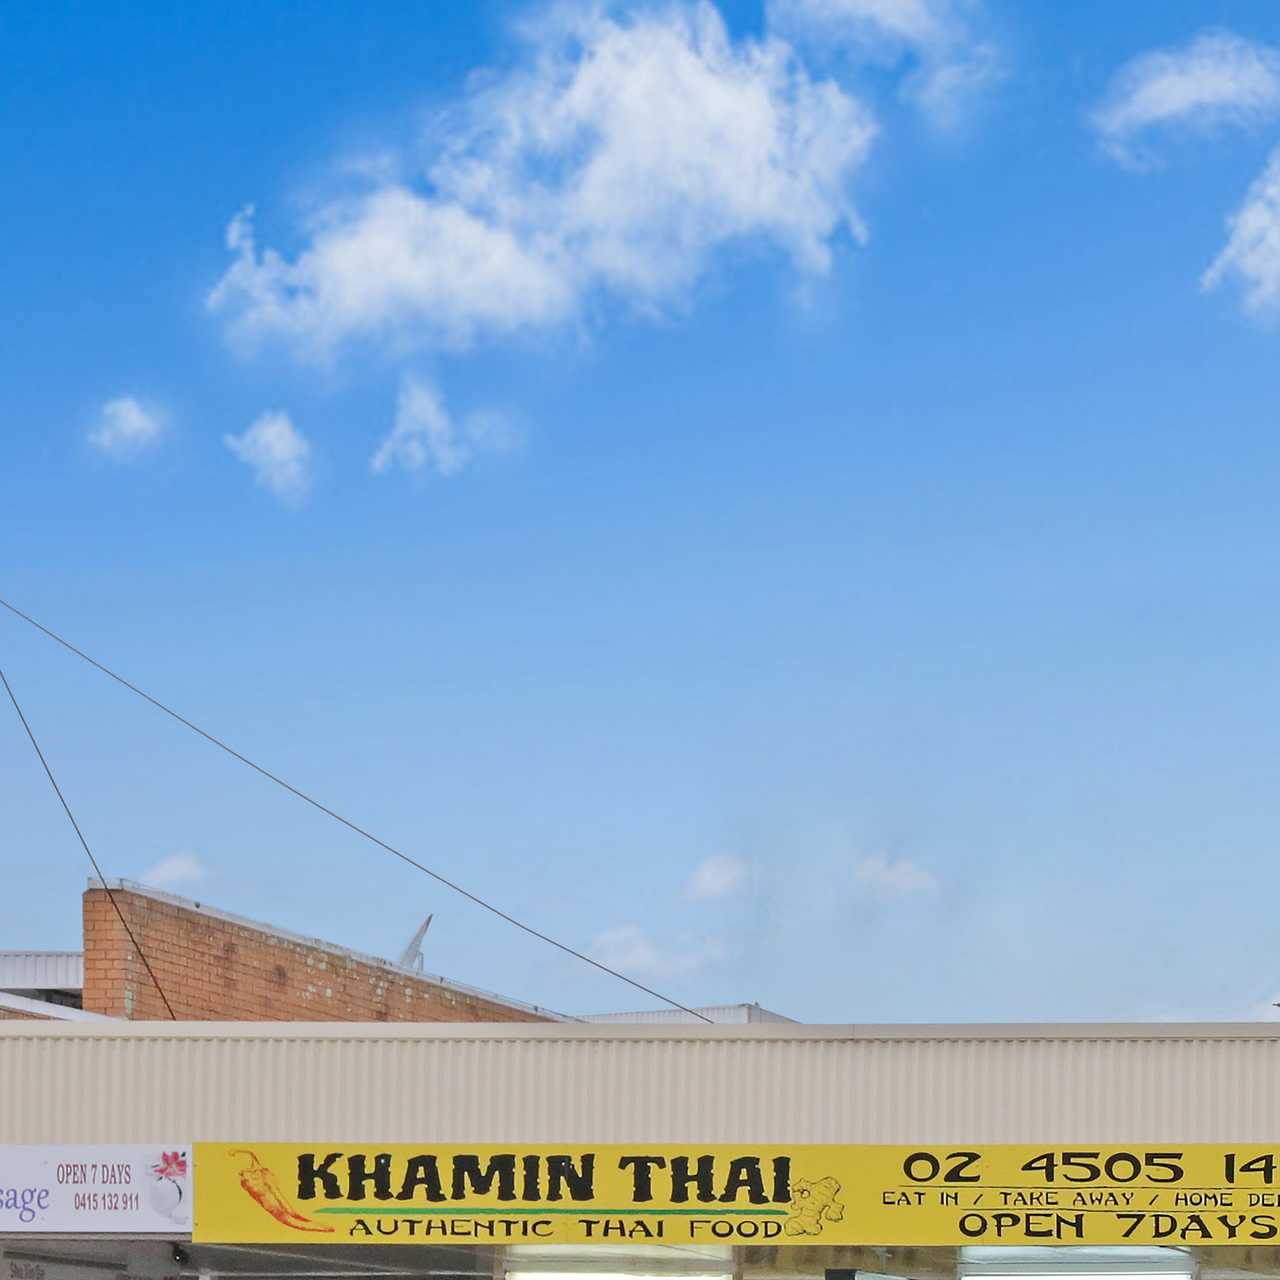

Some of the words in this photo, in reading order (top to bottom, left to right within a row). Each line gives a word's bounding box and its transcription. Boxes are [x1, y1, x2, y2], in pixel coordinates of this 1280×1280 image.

[57, 1163, 87, 1184] OPEN
[91, 1164, 98, 1184] 7
[102, 1164, 131, 1184] DAYS
[903, 1152, 982, 1182] 02
[1021, 1152, 1184, 1183] 4505
[297, 1153, 595, 1202] KHAMIN
[618, 1155, 792, 1204] THAI
[74, 1193, 98, 1210] 0415
[102, 1193, 118, 1210] 132
[122, 1193, 139, 1210] 911
[882, 1191, 926, 1206] EAT
[940, 1191, 959, 1207] IN
[973, 1193, 984, 1206] /
[1000, 1191, 1058, 1207] TAKE
[1073, 1191, 1134, 1207] AWAY
[1149, 1193, 1159, 1206] /
[1175, 1192, 1233, 1208] HOME
[350, 1218, 553, 1237] AUTHENTIC
[578, 1219, 664, 1238] THAI
[690, 1220, 782, 1238] FOOD
[959, 1213, 1085, 1239] OPEN
